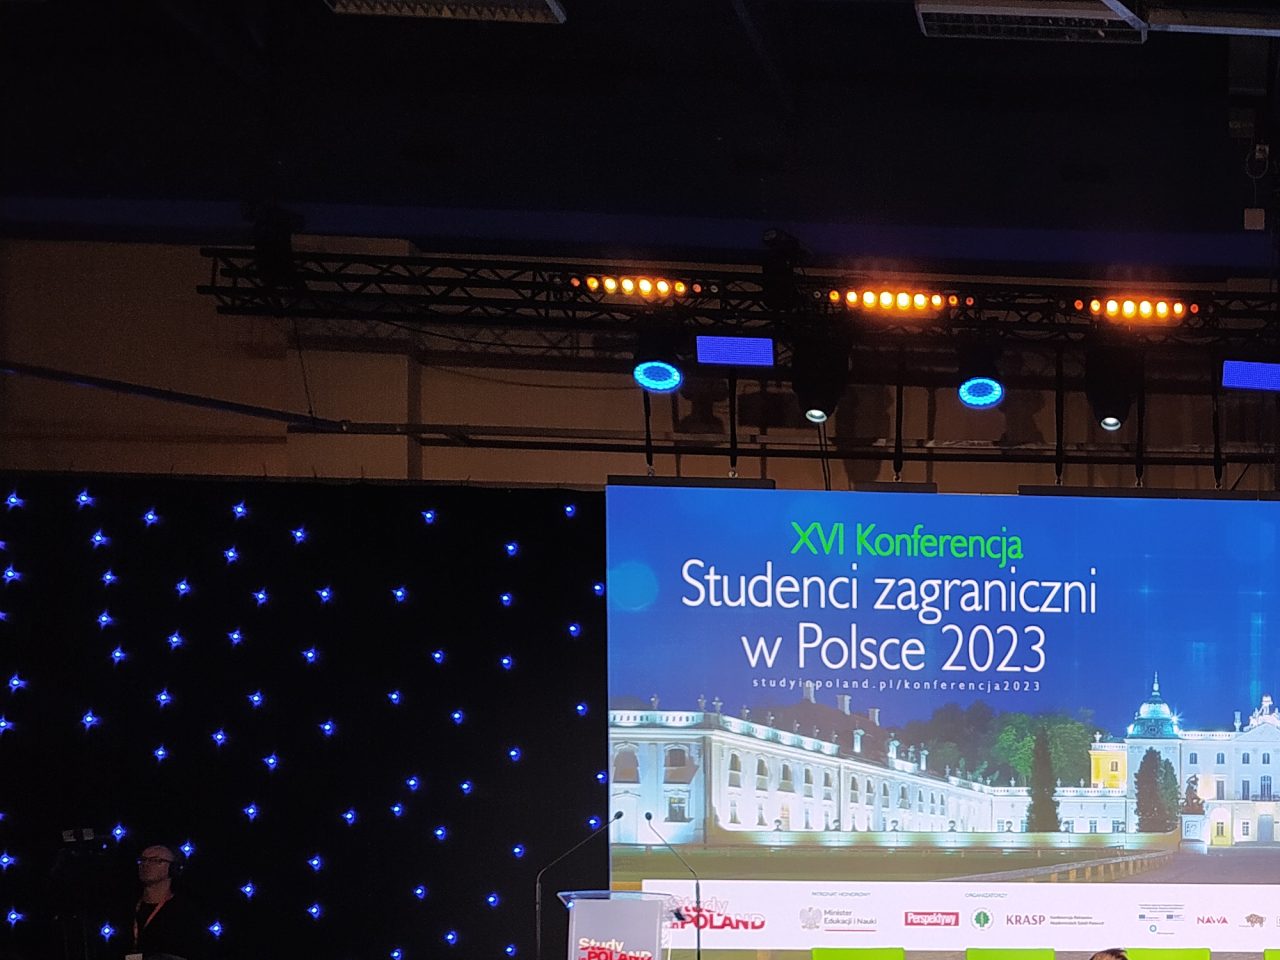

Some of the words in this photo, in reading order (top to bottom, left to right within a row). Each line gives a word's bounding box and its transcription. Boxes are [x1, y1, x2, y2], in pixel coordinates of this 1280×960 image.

[790, 521, 844, 556] XVI
[857, 523, 1023, 567] Konferencja
[681, 558, 858, 611] Studenci
[874, 567, 1096, 624] zagraniczni
[741, 636, 782, 669] w
[798, 622, 925, 671] Polsce
[941, 624, 1046, 673] 2023
[752, 677, 1041, 693] studyinpoland.pl/konferencja2023
[680, 912, 765, 930] POLAND
[1006, 914, 1046, 926] KRASP
[579, 937, 624, 953] Study
